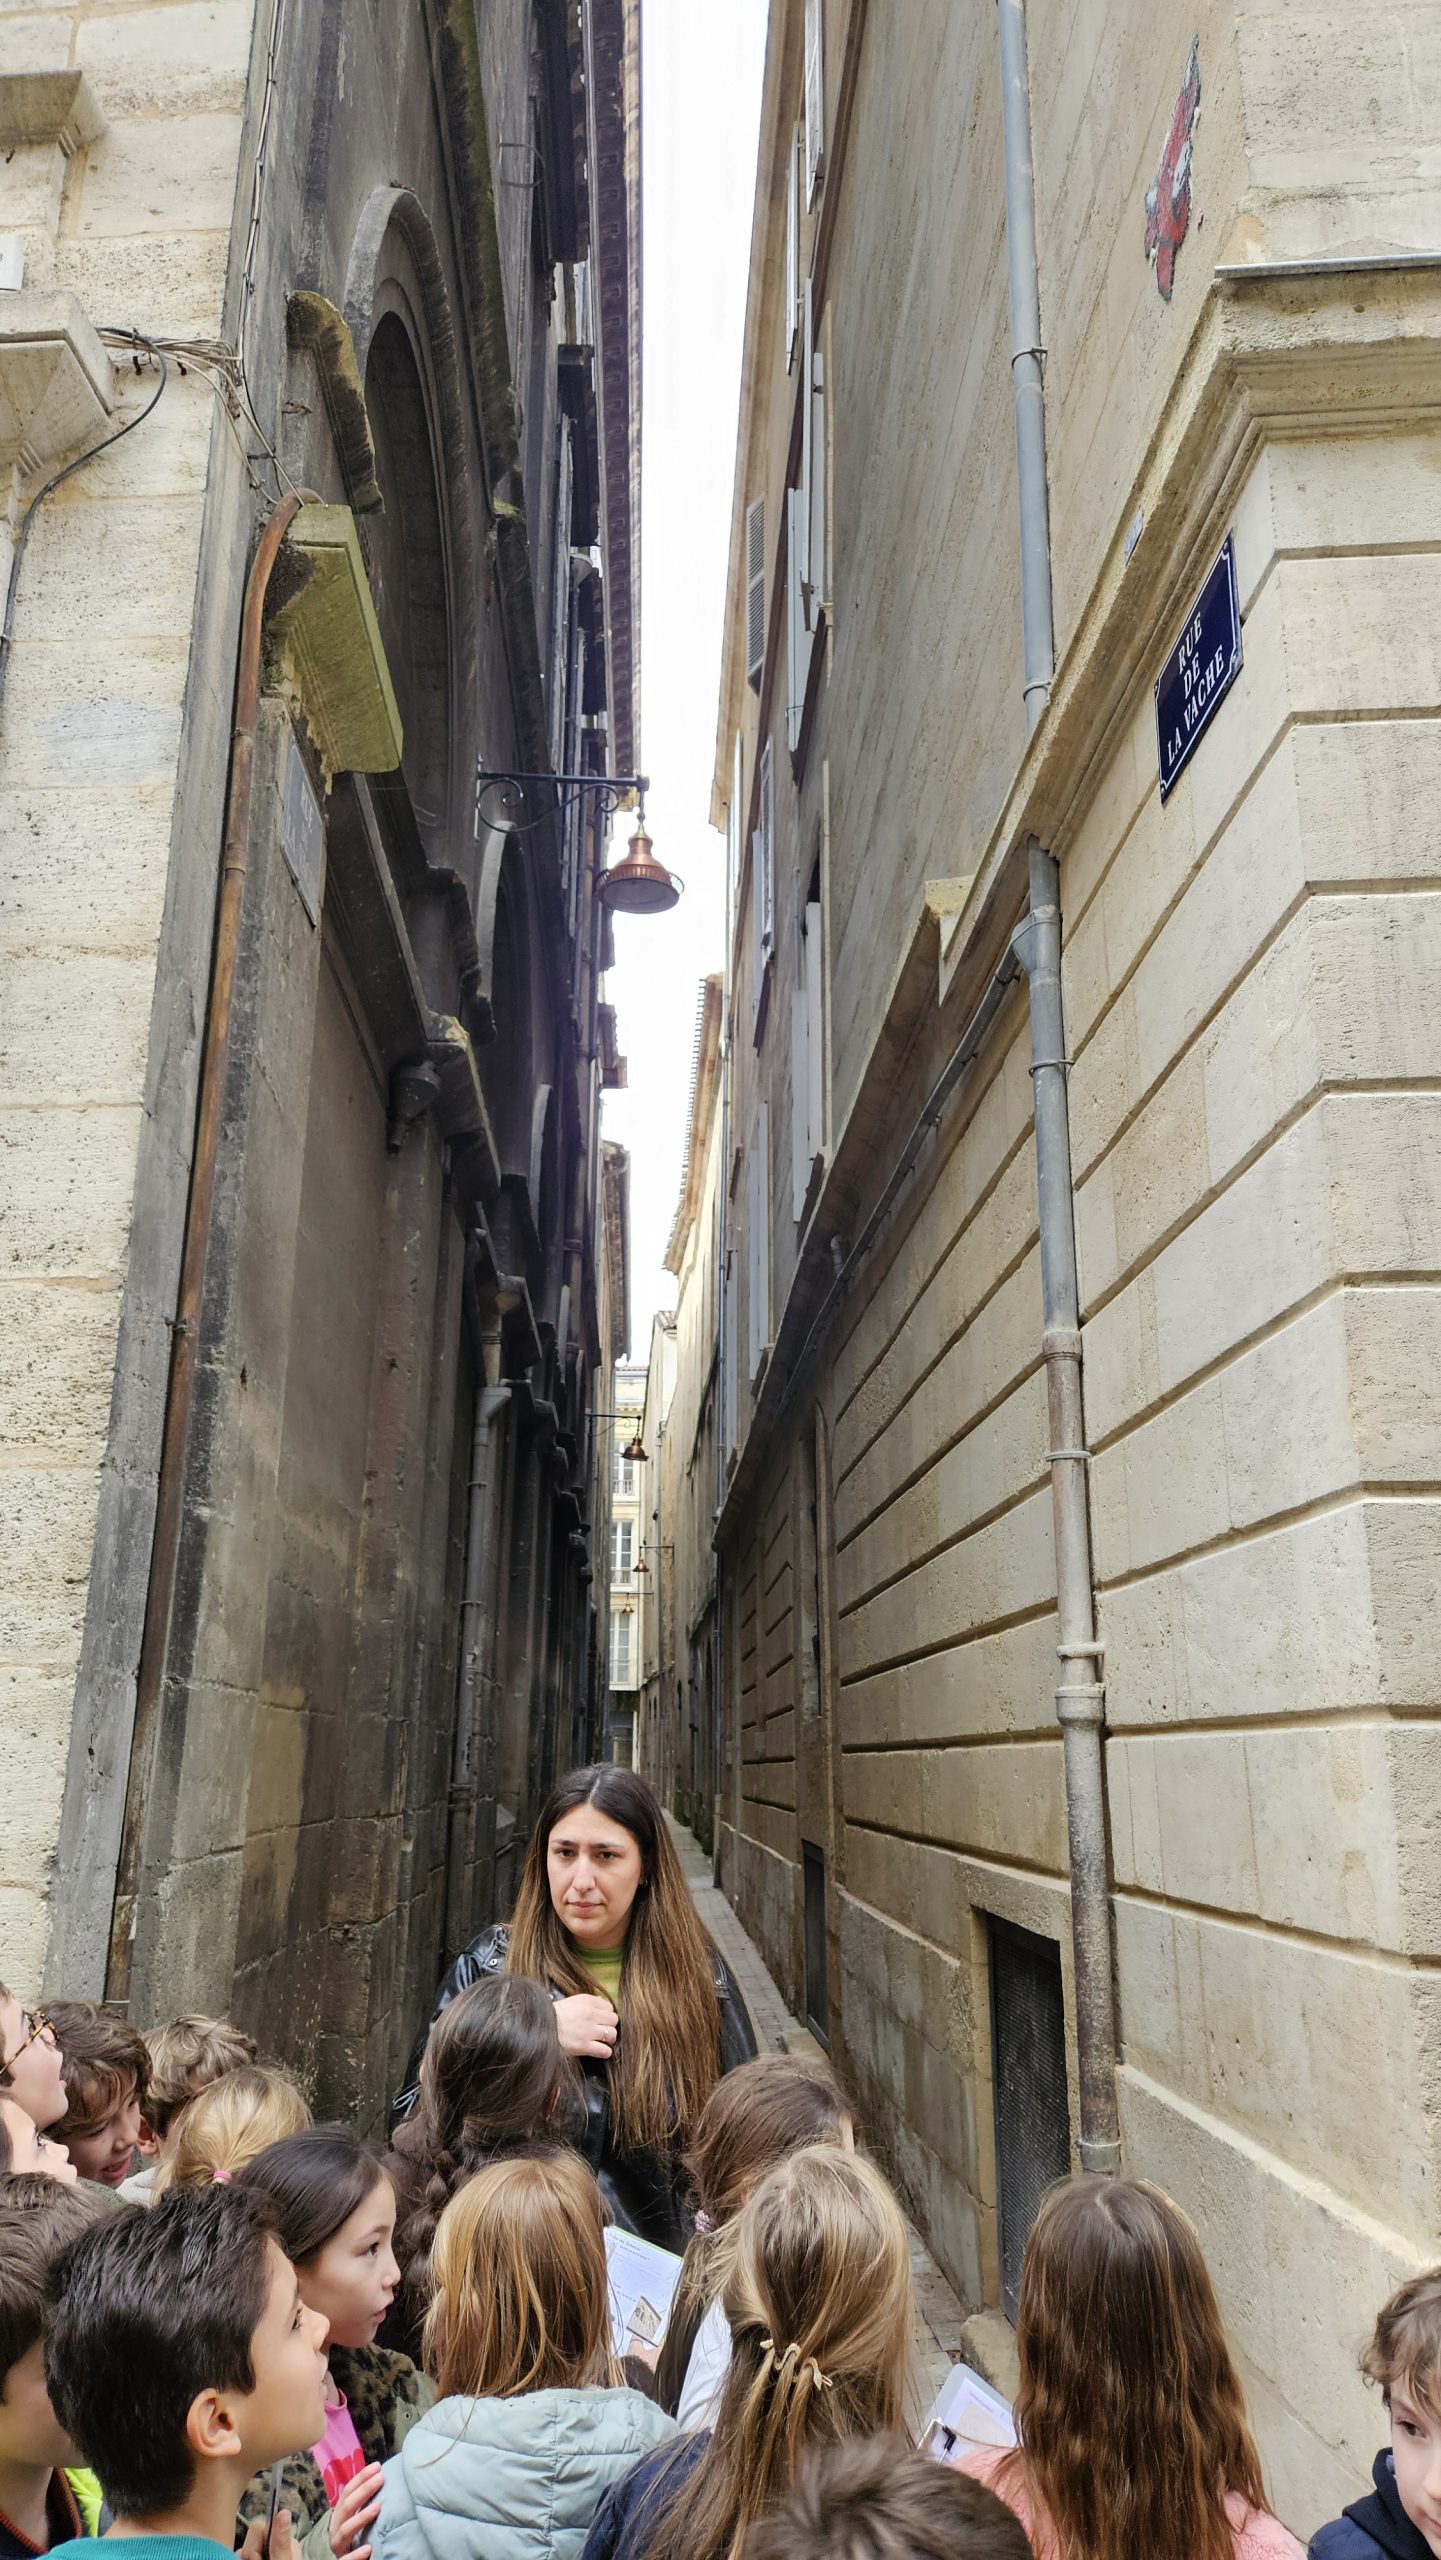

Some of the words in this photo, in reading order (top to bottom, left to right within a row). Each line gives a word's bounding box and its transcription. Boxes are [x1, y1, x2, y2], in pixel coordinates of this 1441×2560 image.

[1178, 611, 1203, 675] RUE
[1183, 651, 1200, 699] DE
[1167, 726, 1182, 767] LA
[1183, 644, 1224, 732] VACHE
